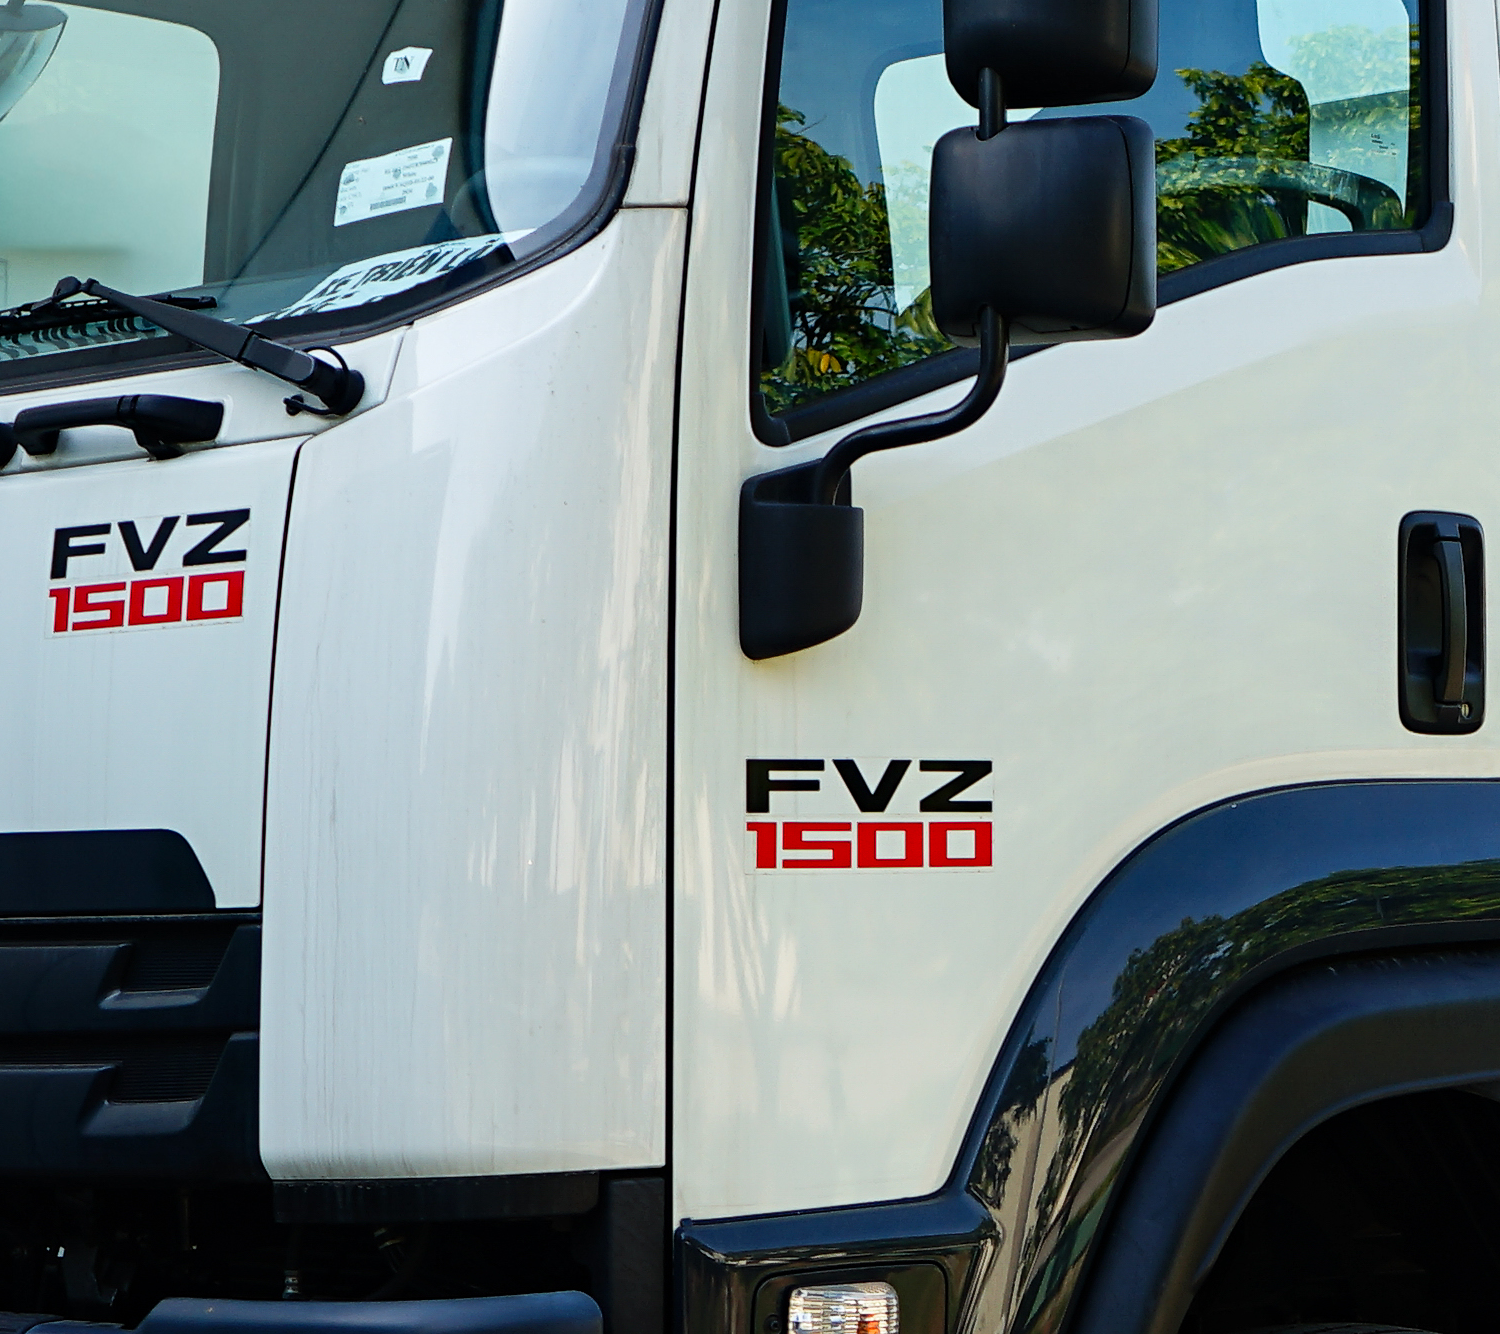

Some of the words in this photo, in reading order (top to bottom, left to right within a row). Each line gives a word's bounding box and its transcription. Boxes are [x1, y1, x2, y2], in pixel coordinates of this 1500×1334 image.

[50, 507, 251, 579] FVZ
[49, 570, 245, 633] 1500
[745, 758, 993, 814] FVZ
[745, 821, 993, 869] 1500
